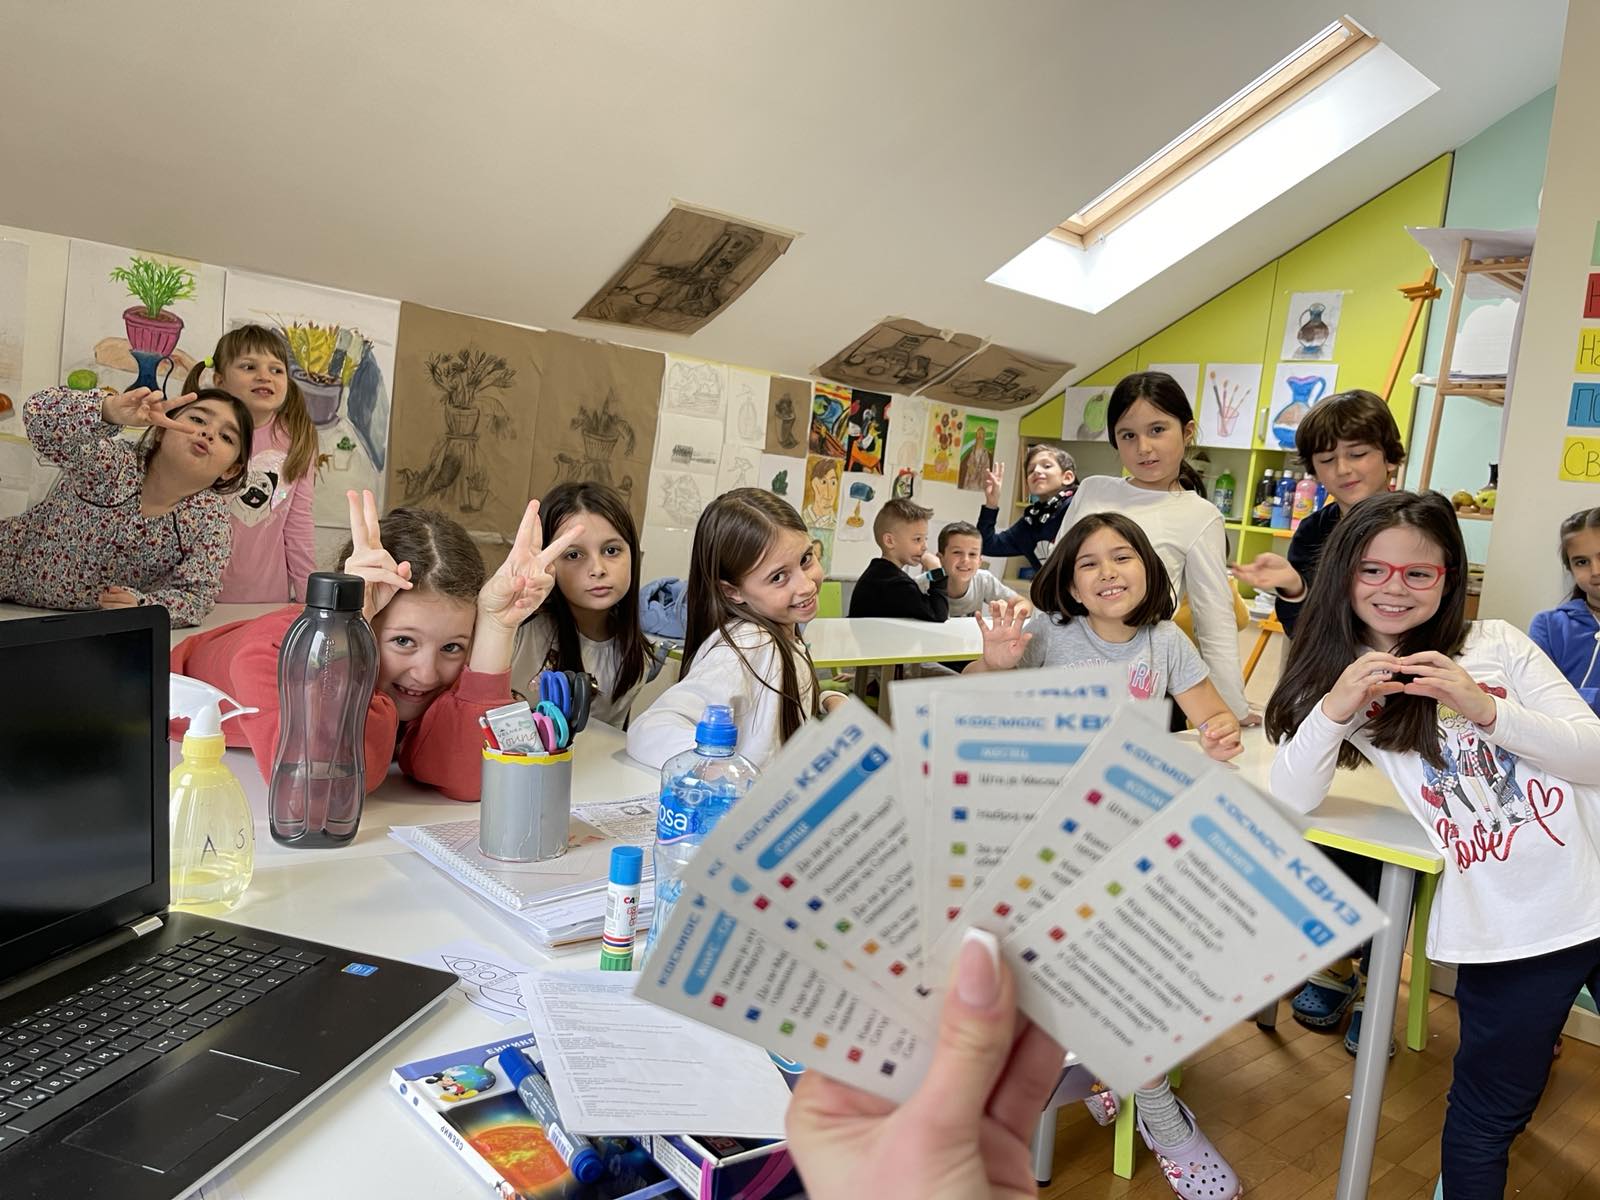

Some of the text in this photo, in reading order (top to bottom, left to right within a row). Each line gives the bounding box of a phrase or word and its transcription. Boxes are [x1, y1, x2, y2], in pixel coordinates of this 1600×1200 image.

[954, 714, 1045, 729] КОСМОС
[734, 723, 862, 851] КОСМОС КВИЗ
[1215, 793, 1361, 926] КОСМОС КВИЗ
